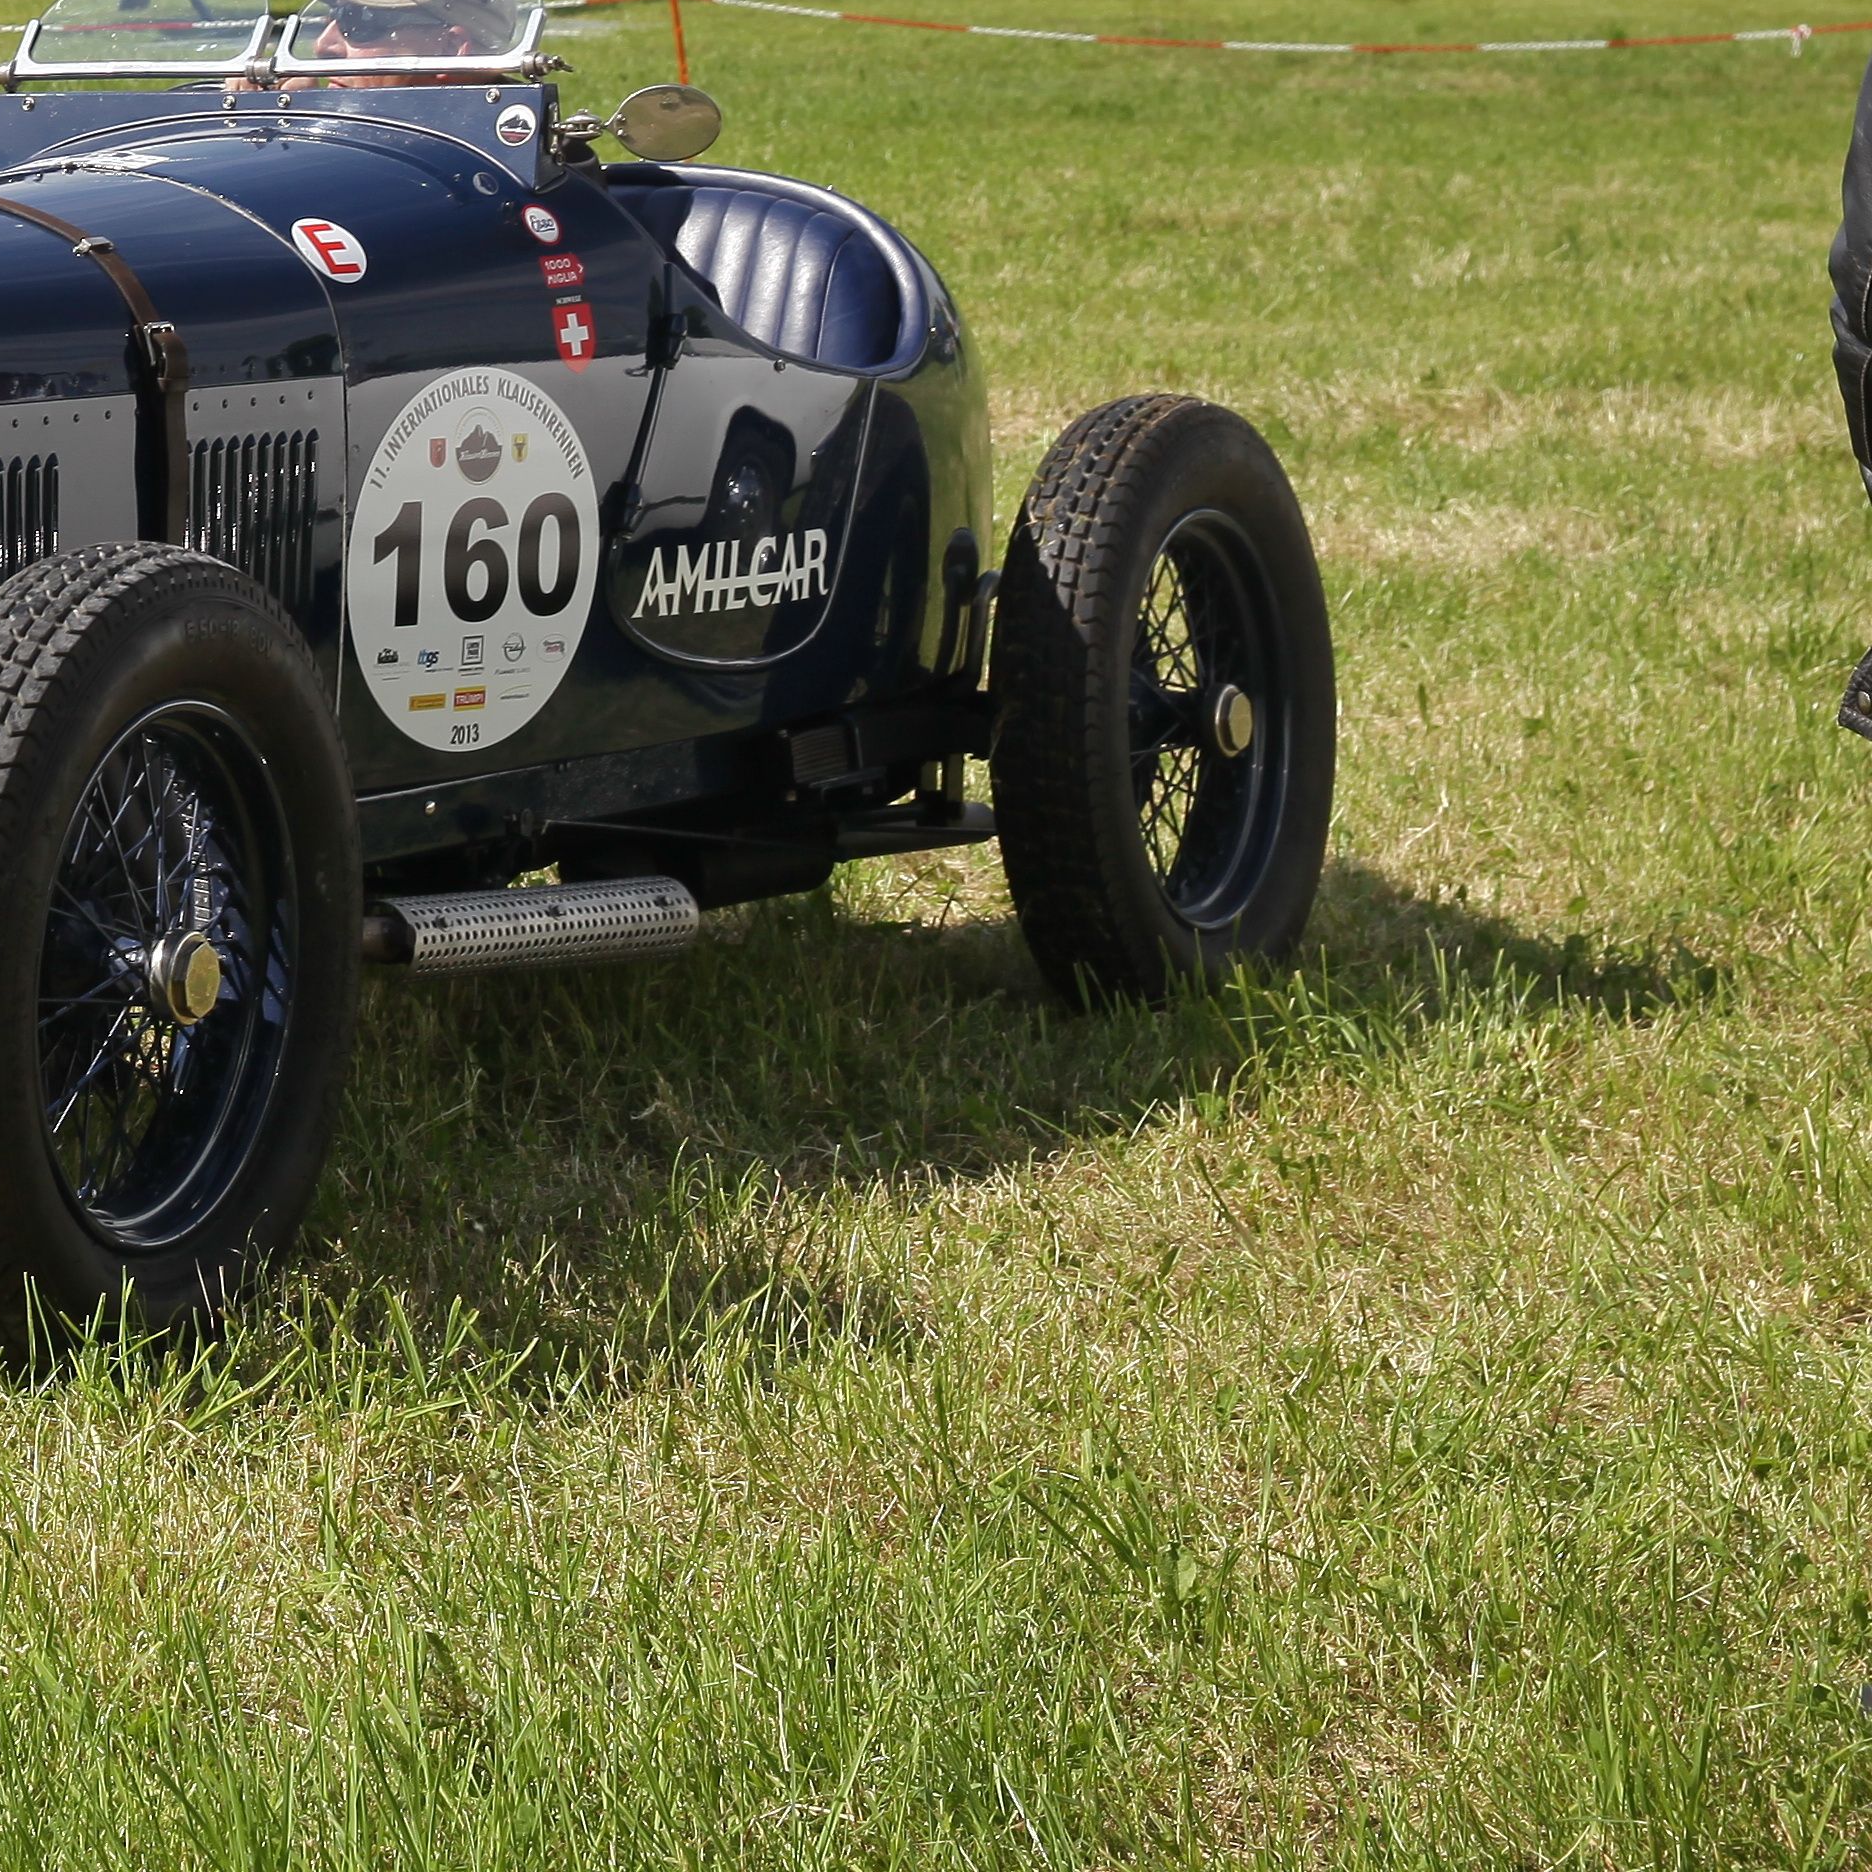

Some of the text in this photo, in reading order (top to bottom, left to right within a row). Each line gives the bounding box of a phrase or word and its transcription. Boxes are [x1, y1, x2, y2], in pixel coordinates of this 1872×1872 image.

[297, 223, 361, 274] E
[530, 215, 555, 232] Esso
[545, 258, 571, 270] 1000
[370, 375, 584, 489] 11. INTERNATIONALES KLAUSENRENNEN
[373, 492, 581, 627] 160
[631, 528, 829, 618] AMILCAR
[450, 723, 479, 744] 2013
